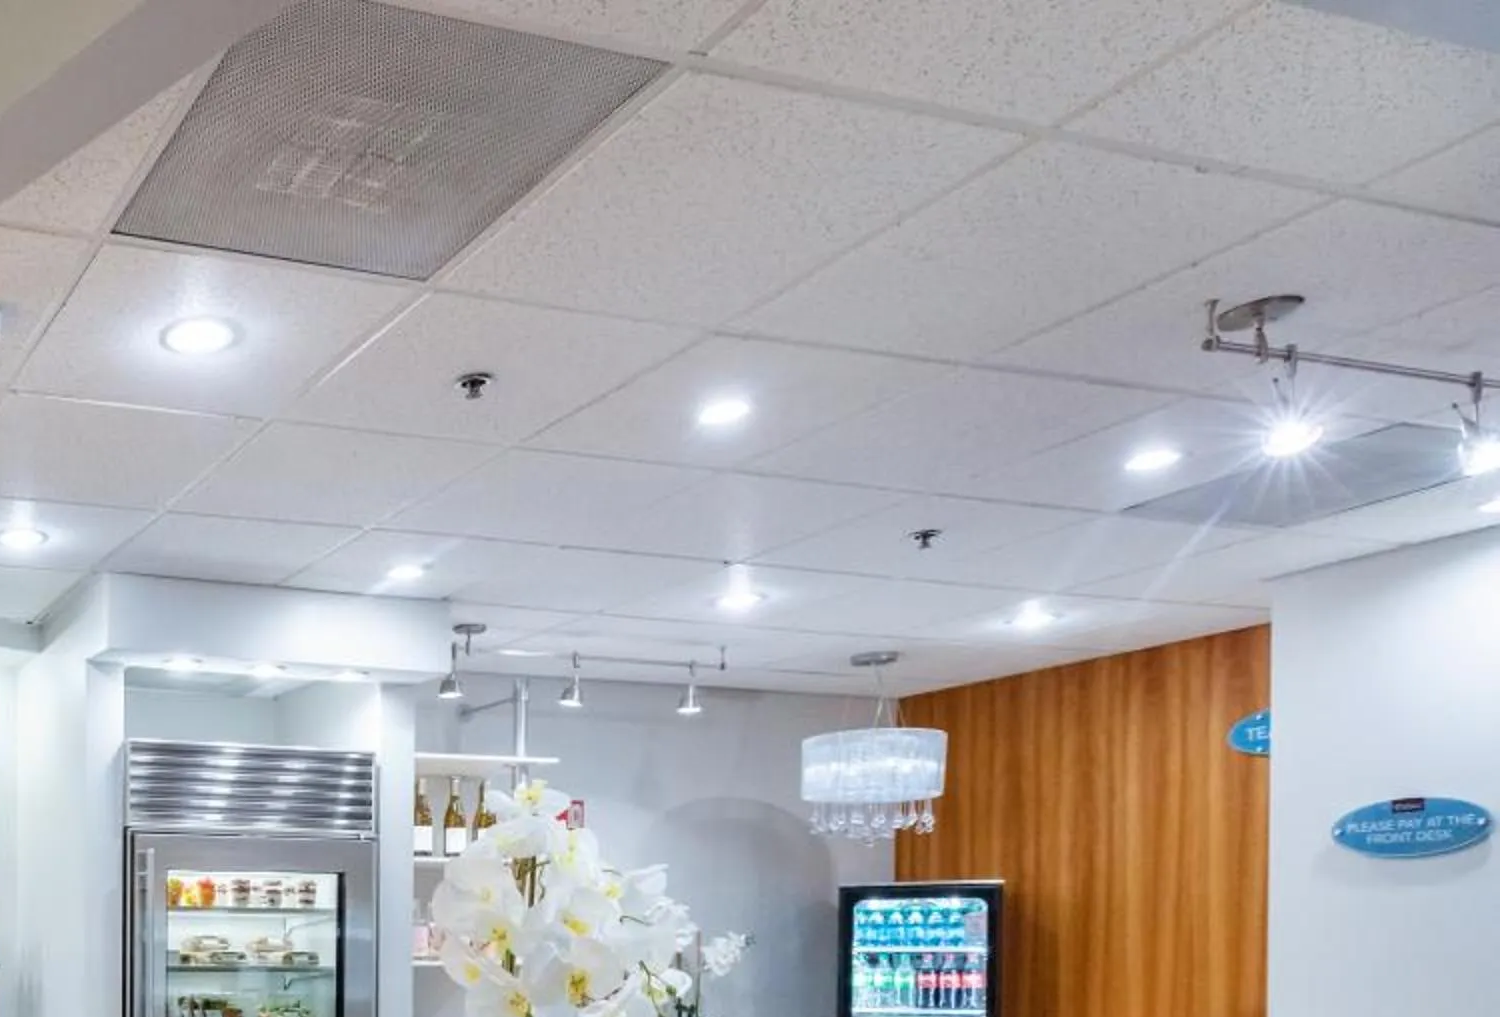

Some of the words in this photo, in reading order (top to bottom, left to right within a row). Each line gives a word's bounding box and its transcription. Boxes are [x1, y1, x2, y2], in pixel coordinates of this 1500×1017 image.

[1244, 725, 1269, 740] TE
[1347, 819, 1395, 834] PLEASE
[1399, 817, 1423, 830] PAY
[1427, 815, 1445, 828] AT
[1449, 813, 1477, 826] THE
[1366, 831, 1412, 845] FRONT
[1415, 829, 1453, 842] DESK
